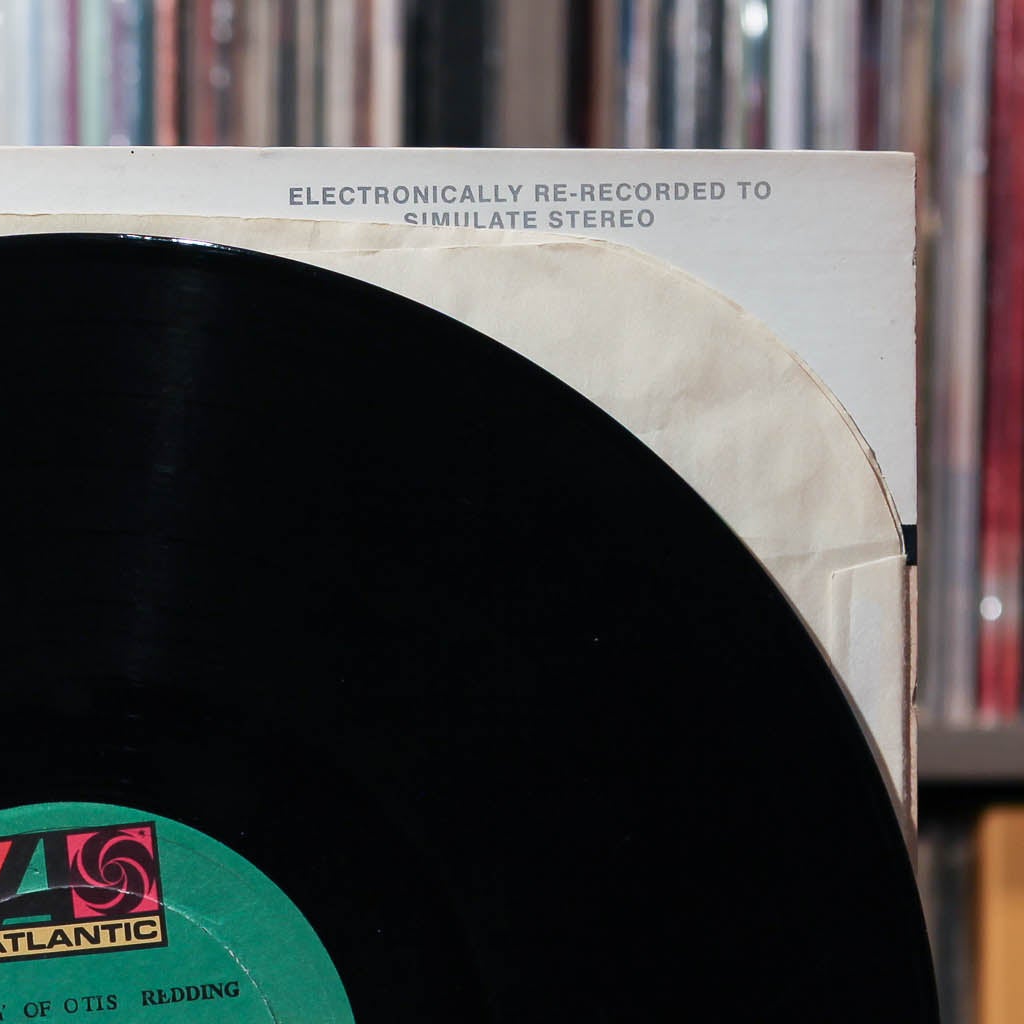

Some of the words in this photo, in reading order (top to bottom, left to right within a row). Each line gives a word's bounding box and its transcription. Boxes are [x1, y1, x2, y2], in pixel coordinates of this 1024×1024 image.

[289, 185, 524, 205] ELECTRONICALLY
[535, 182, 726, 202] RE-RECORDED
[737, 181, 772, 199] TO
[404, 211, 537, 229] SIMULATE
[549, 209, 655, 229] STEREO
[23, 1001, 51, 1018] OF
[63, 994, 118, 1013] OTIS
[141, 981, 241, 1006] REDDING
